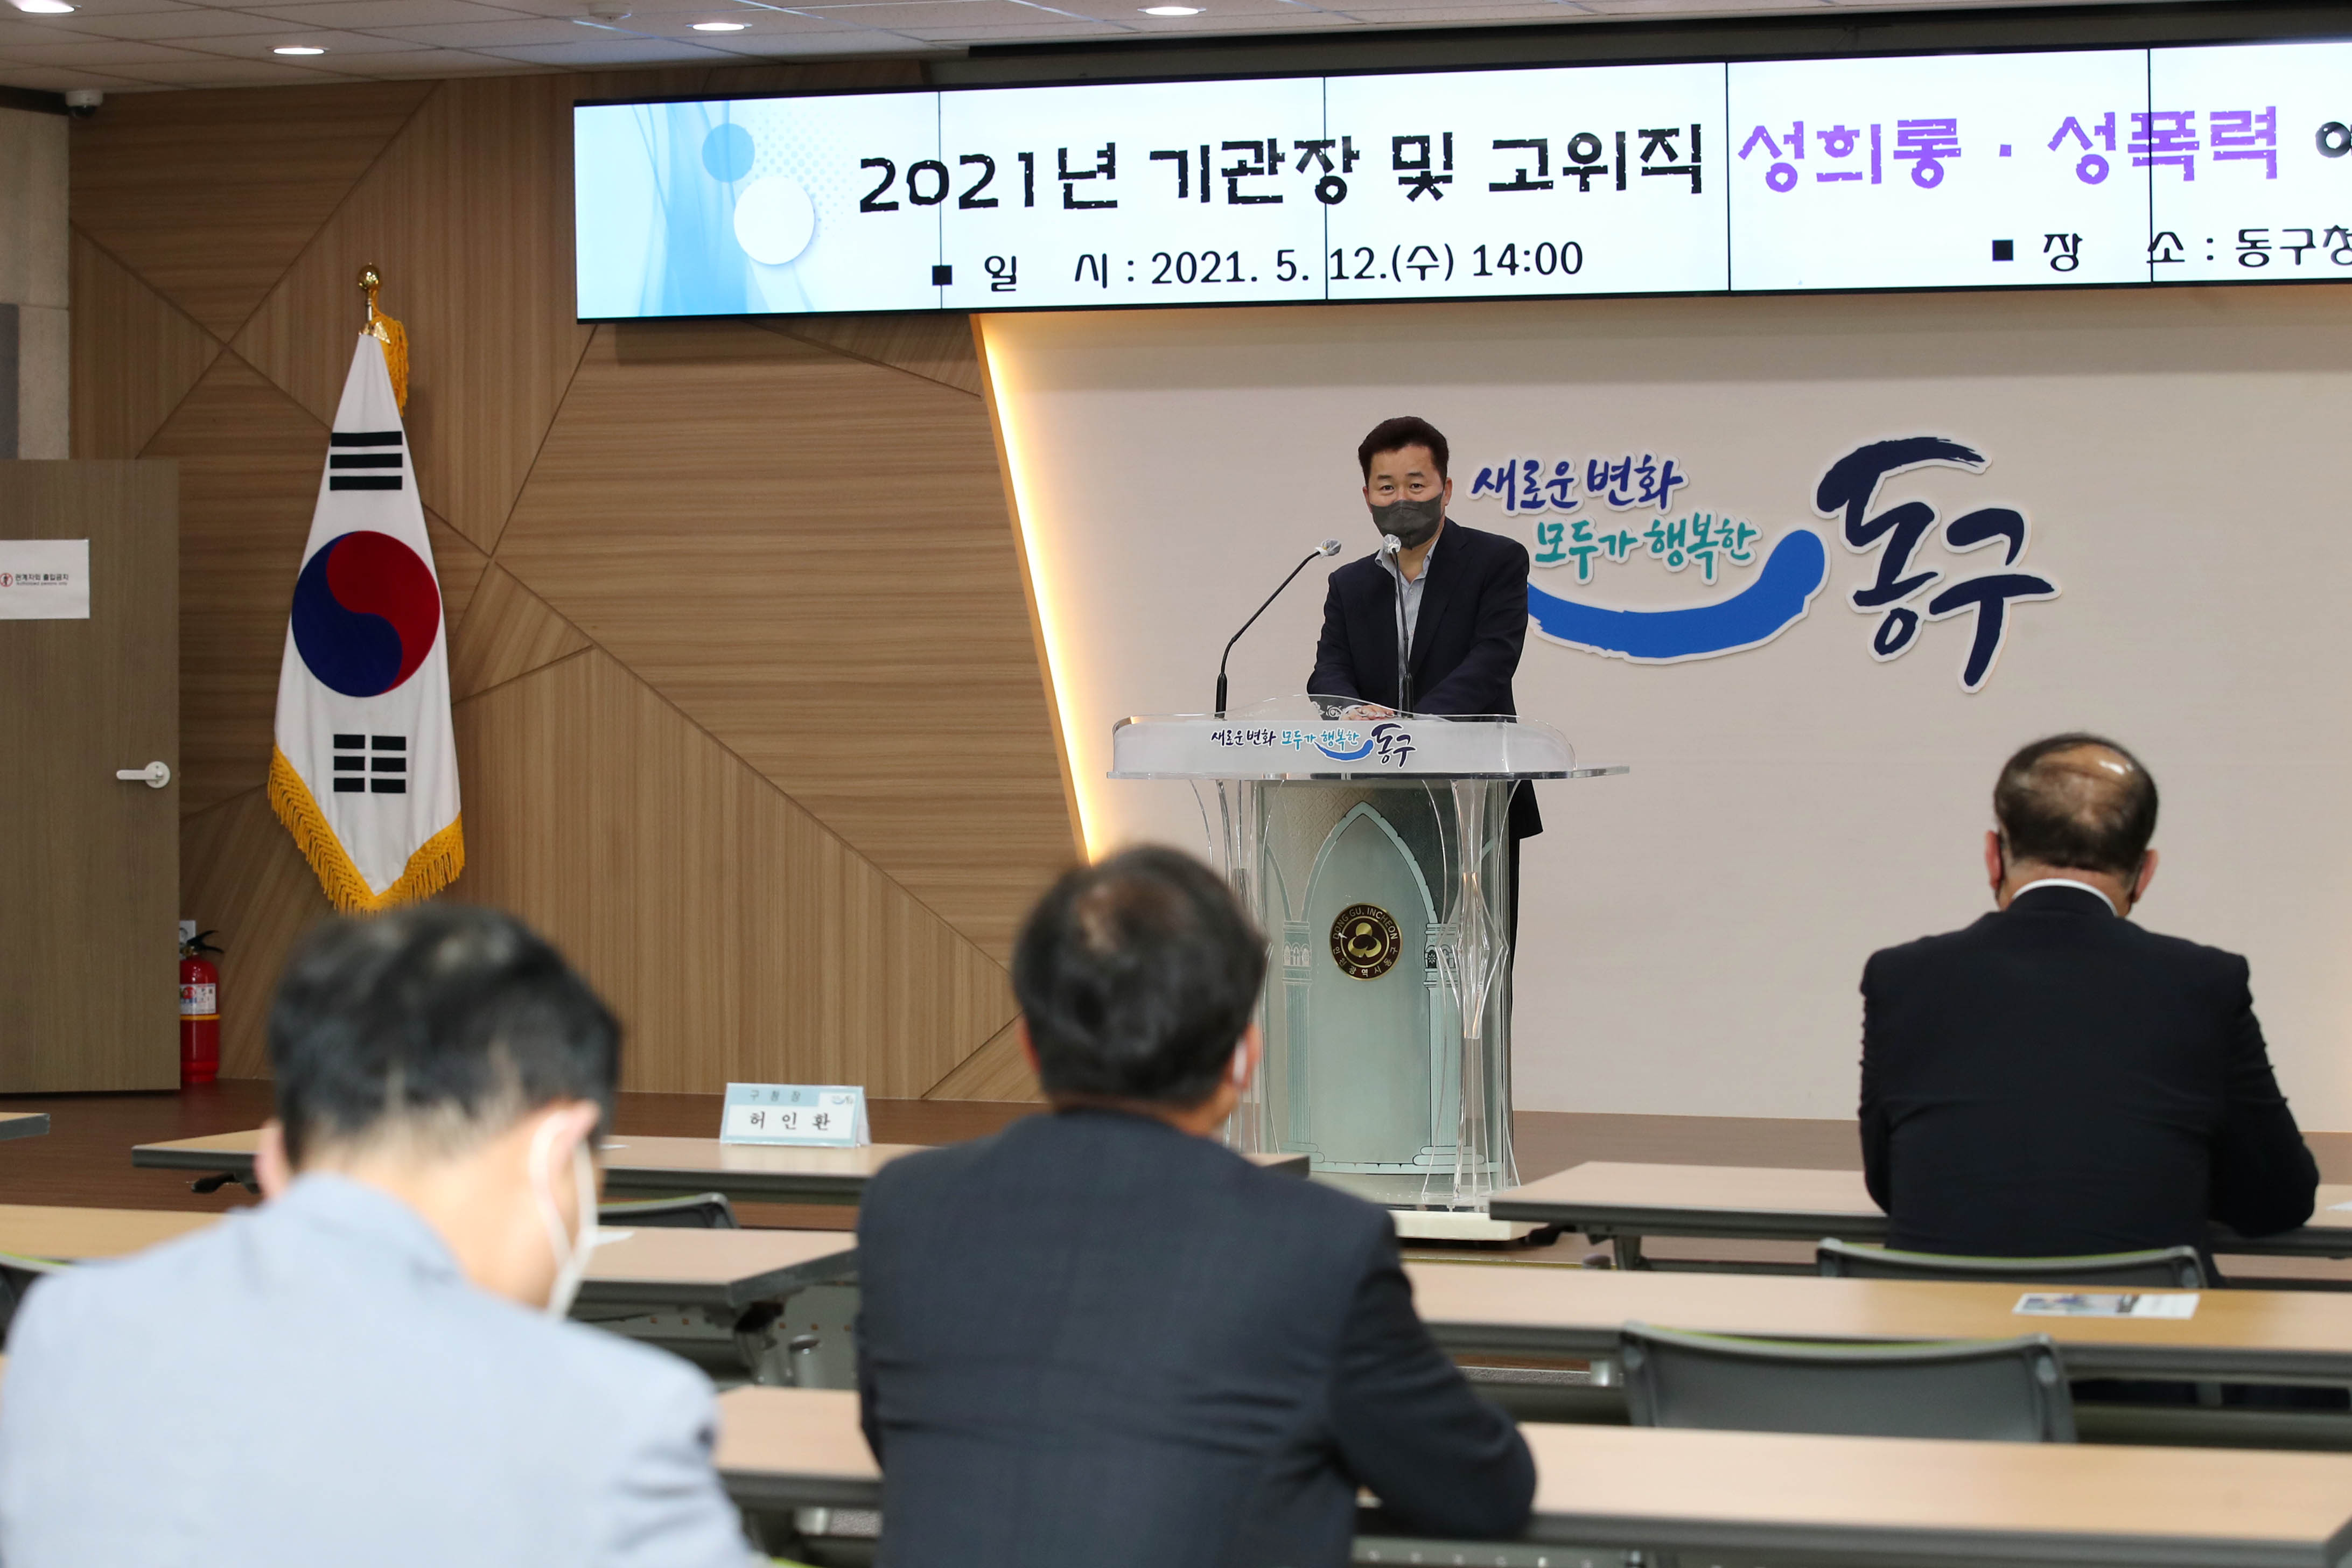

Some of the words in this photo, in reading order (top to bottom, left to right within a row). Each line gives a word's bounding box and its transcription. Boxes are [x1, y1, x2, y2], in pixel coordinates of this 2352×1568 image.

[860, 142, 1118, 213] 2021년
[1150, 135, 1361, 205] 기관장
[1392, 132, 1454, 202] 및
[1489, 124, 1703, 194] 고위직
[1738, 118, 1963, 193] 성희롱
[2047, 106, 2278, 185] 성폭력
[1152, 250, 1258, 285] 2021.
[1277, 248, 1310, 282] 5.
[1473, 241, 1584, 277] 14:00
[1471, 459, 1578, 512] 새로운
[1586, 453, 1684, 510] 변화
[1535, 519, 1638, 580] 모두가
[1643, 512, 1757, 580] 행복한
[1817, 436, 2055, 687] 동구
[1211, 729, 1245, 747] 새로운
[1246, 728, 1277, 747] 변화
[1282, 730, 1317, 750] 모두가
[1320, 728, 1360, 751] 행복한
[1371, 723, 1416, 768] 동구
[1333, 914, 1349, 940] DONG
[1367, 907, 1398, 940] INCHEON
